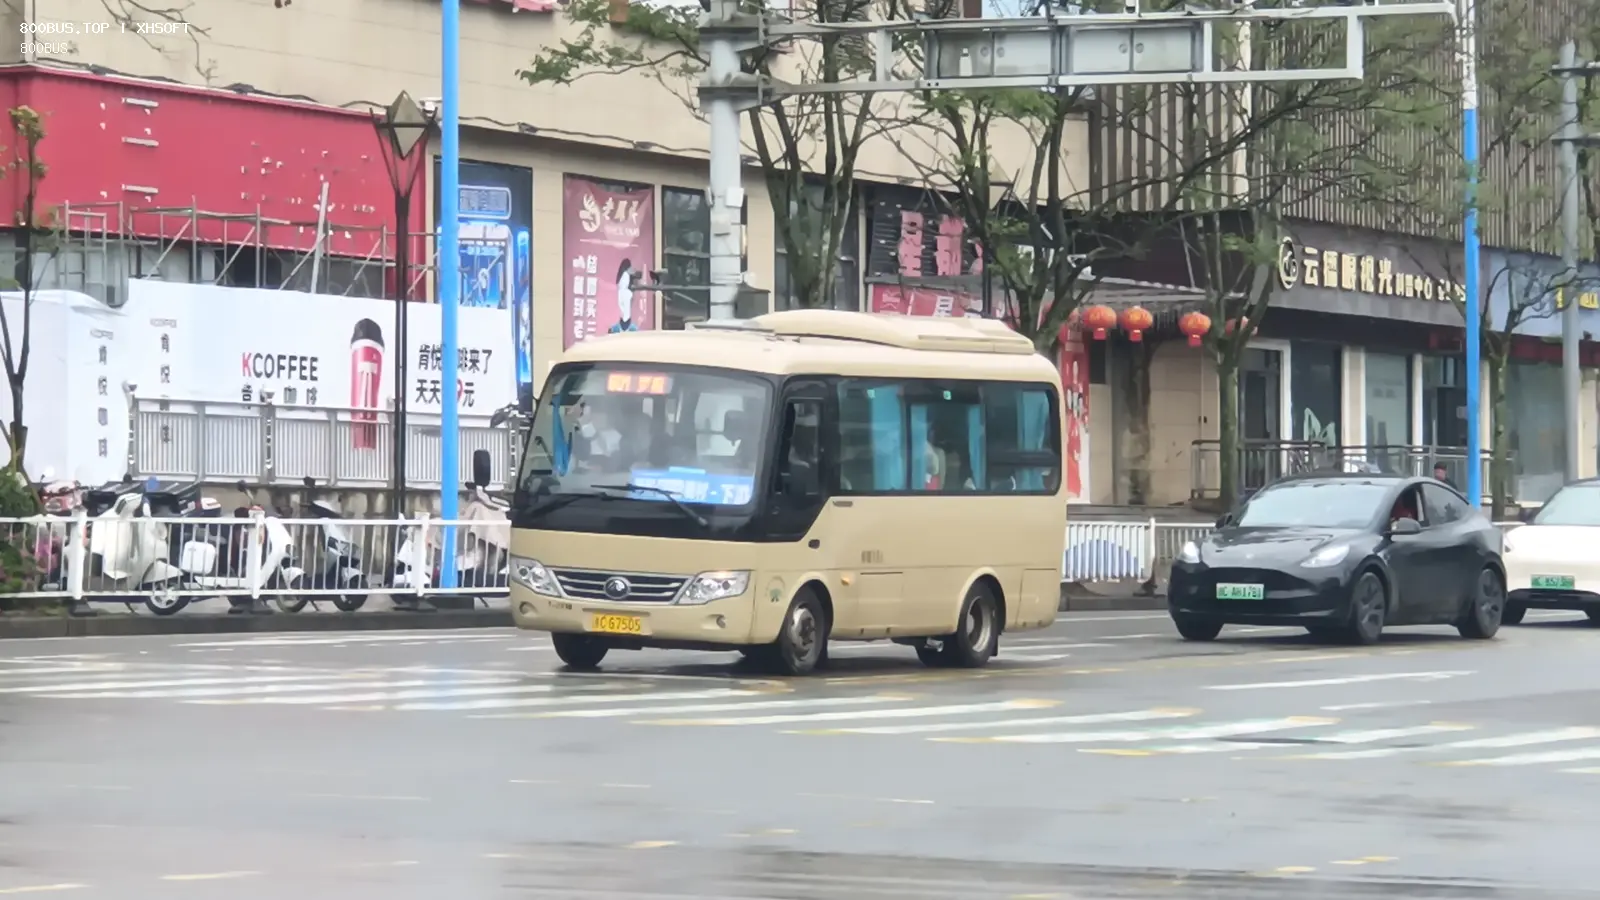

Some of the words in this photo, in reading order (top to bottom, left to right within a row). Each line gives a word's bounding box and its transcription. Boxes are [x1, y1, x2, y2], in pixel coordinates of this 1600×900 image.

[241, 351, 319, 381] KCOFFEE
[418, 344, 493, 374] 肯悦啡来了
